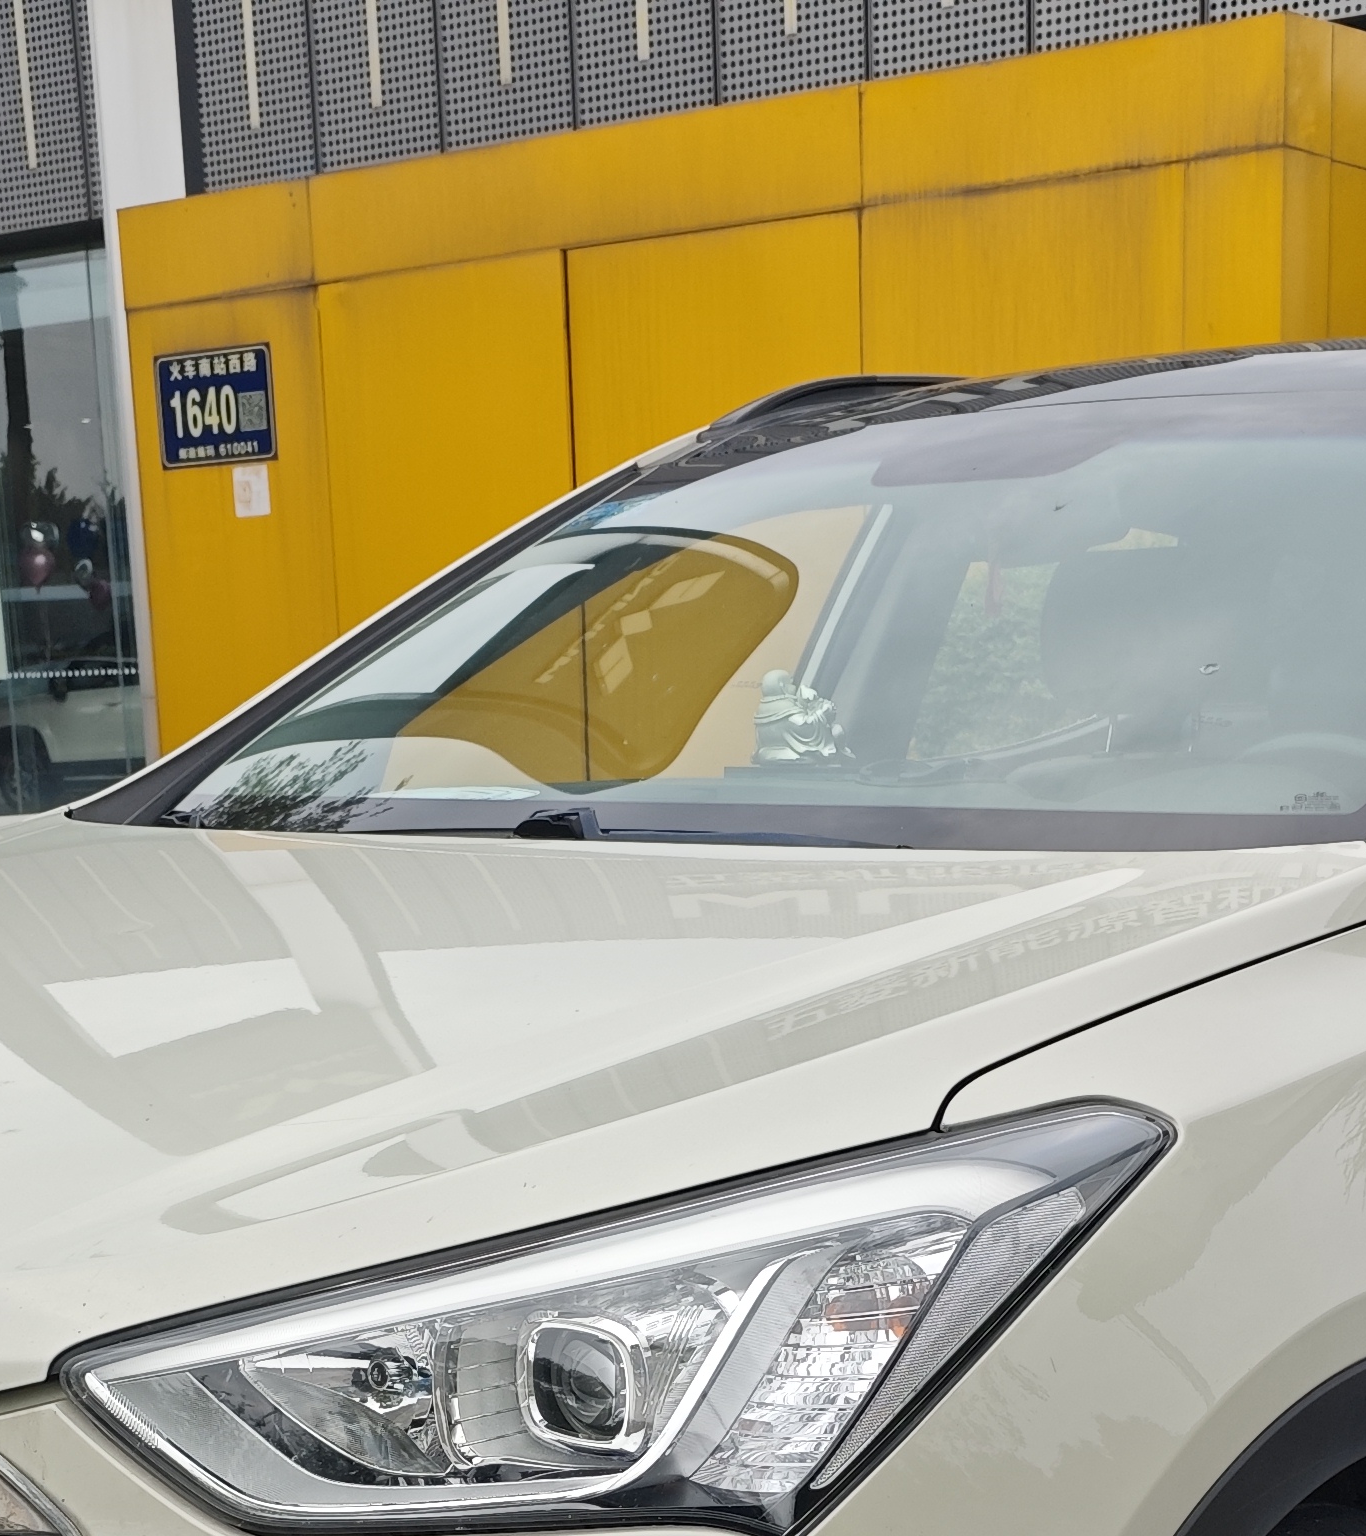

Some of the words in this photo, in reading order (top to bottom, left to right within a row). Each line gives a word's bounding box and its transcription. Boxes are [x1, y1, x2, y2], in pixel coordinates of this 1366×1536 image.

[169, 352, 257, 381] 火车南站西路
[170, 385, 237, 438] 1640
[219, 440, 259, 457] 610041
